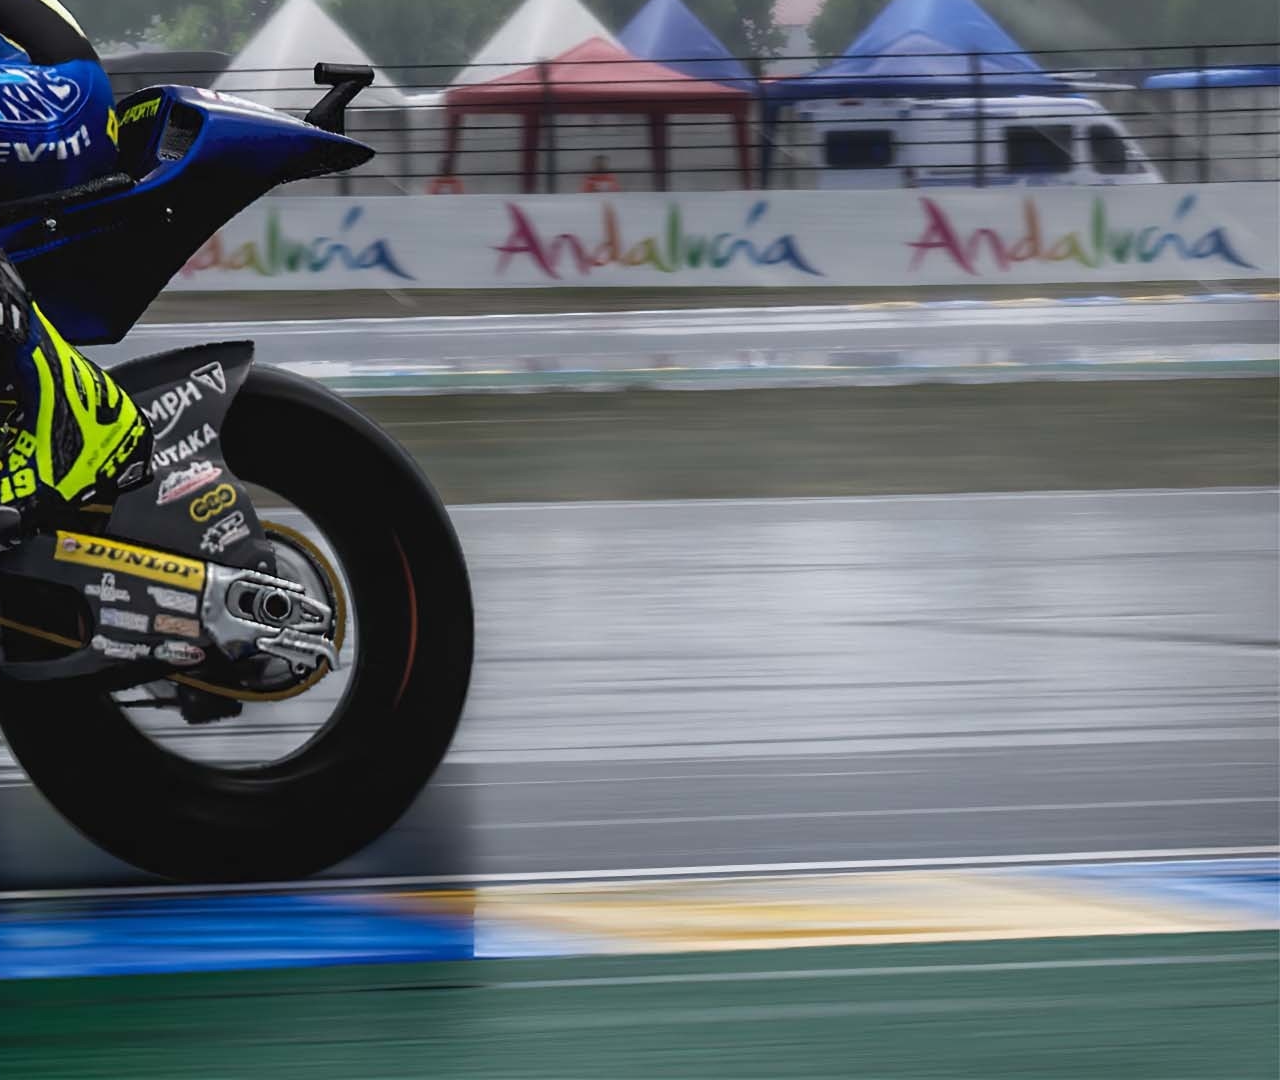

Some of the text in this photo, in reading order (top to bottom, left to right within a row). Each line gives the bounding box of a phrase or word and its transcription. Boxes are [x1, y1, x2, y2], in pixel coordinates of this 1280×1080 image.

[180, 205, 417, 281] dalucía
[492, 202, 826, 280] Andalucía
[905, 194, 1262, 276] Andalucía
[0, 467, 38, 505] 19
[84, 542, 200, 578] DUNLOP
